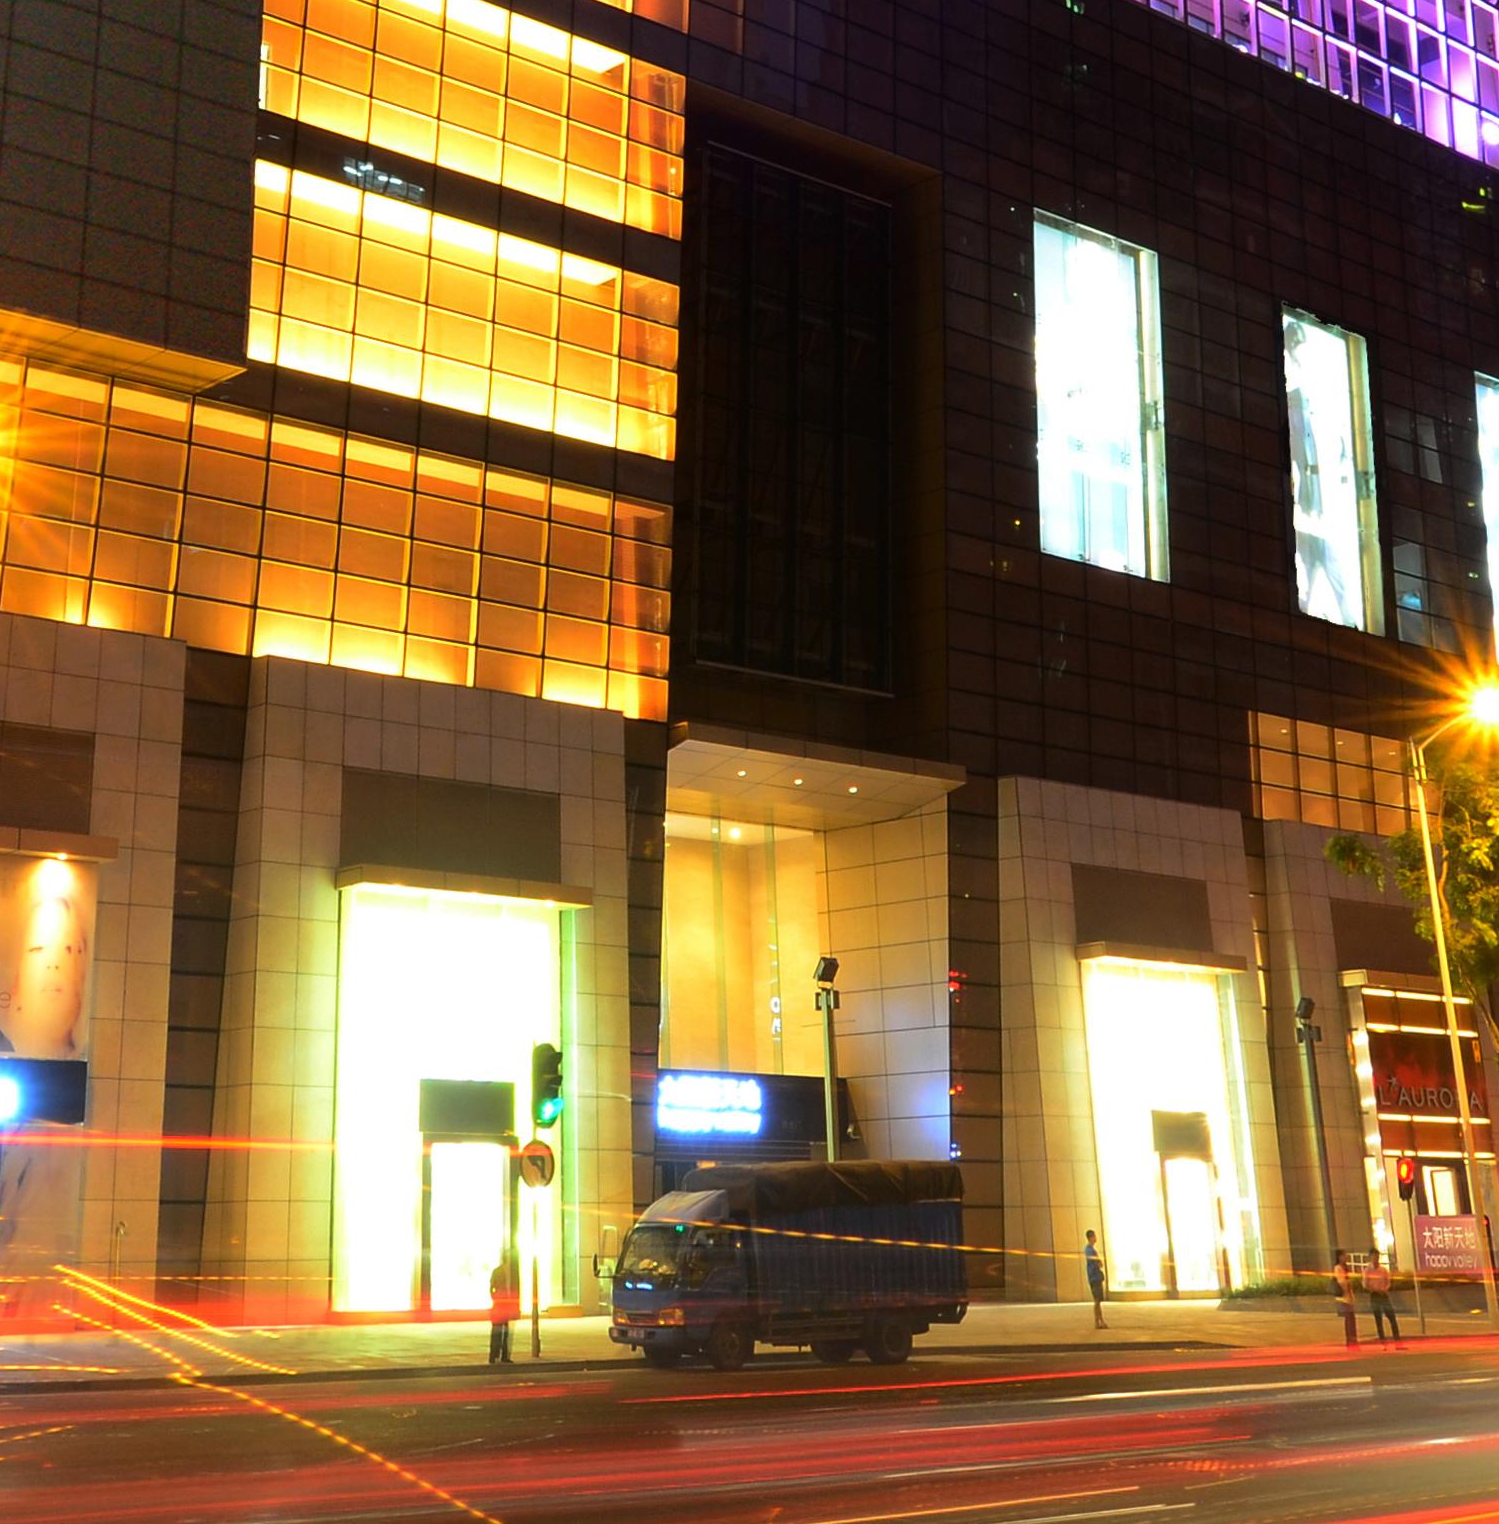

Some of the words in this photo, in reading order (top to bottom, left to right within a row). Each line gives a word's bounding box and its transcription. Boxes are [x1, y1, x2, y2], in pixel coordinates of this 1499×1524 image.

[1378, 1077, 1483, 1111] L'AUROA
[1422, 1226, 1477, 1250] 太阳新天地
